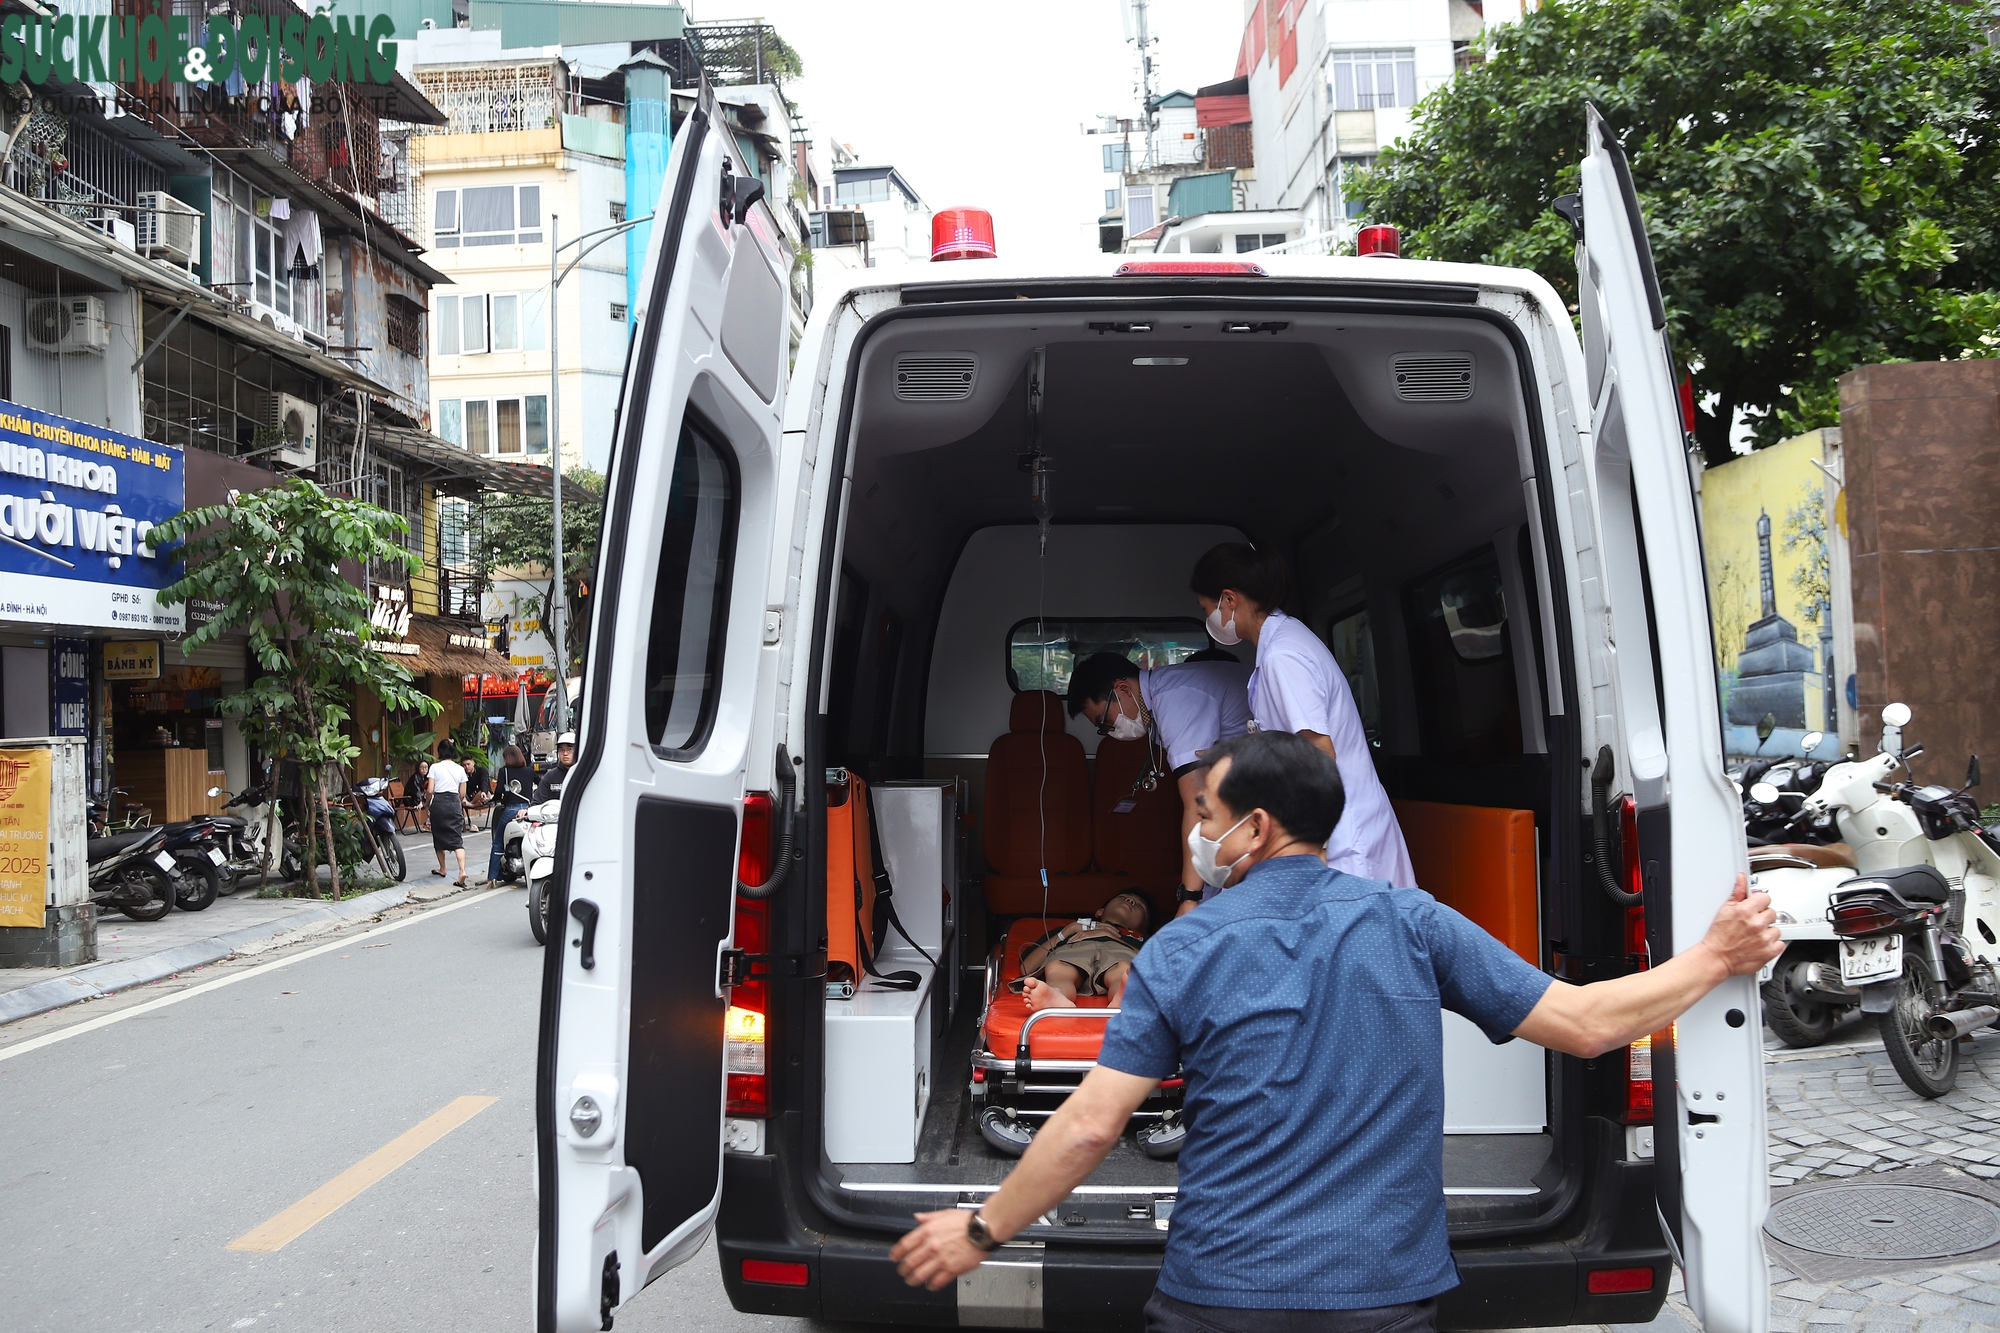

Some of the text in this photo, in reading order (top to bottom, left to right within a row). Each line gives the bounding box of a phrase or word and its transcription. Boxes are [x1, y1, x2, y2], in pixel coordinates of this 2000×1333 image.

[0, 413, 31, 435] KHÁM
[33, 422, 73, 445] CHUYÊN
[74, 435, 100, 453] KHOA
[101, 438, 126, 459] RĂNG
[132, 446, 150, 466] HÀM
[155, 452, 171, 472] MẶT
[47, 453, 117, 494] KHOA
[0, 490, 74, 546] CƯỜI
[75, 504, 136, 569] VIỆT
[111, 592, 129, 603] GPHĐ
[6, 601, 22, 613] ĐÌNH
[26, 603, 35, 614] HÀ
[36, 603, 48, 618] NỘI
[61, 647, 85, 679] CÔNG
[107, 657, 136, 670] BÁNH
[61, 698, 85, 733] NGHỆ
[13, 843, 19, 852] 2
[0, 857, 41, 874] 2025
[1861, 941, 1876, 955] 29
